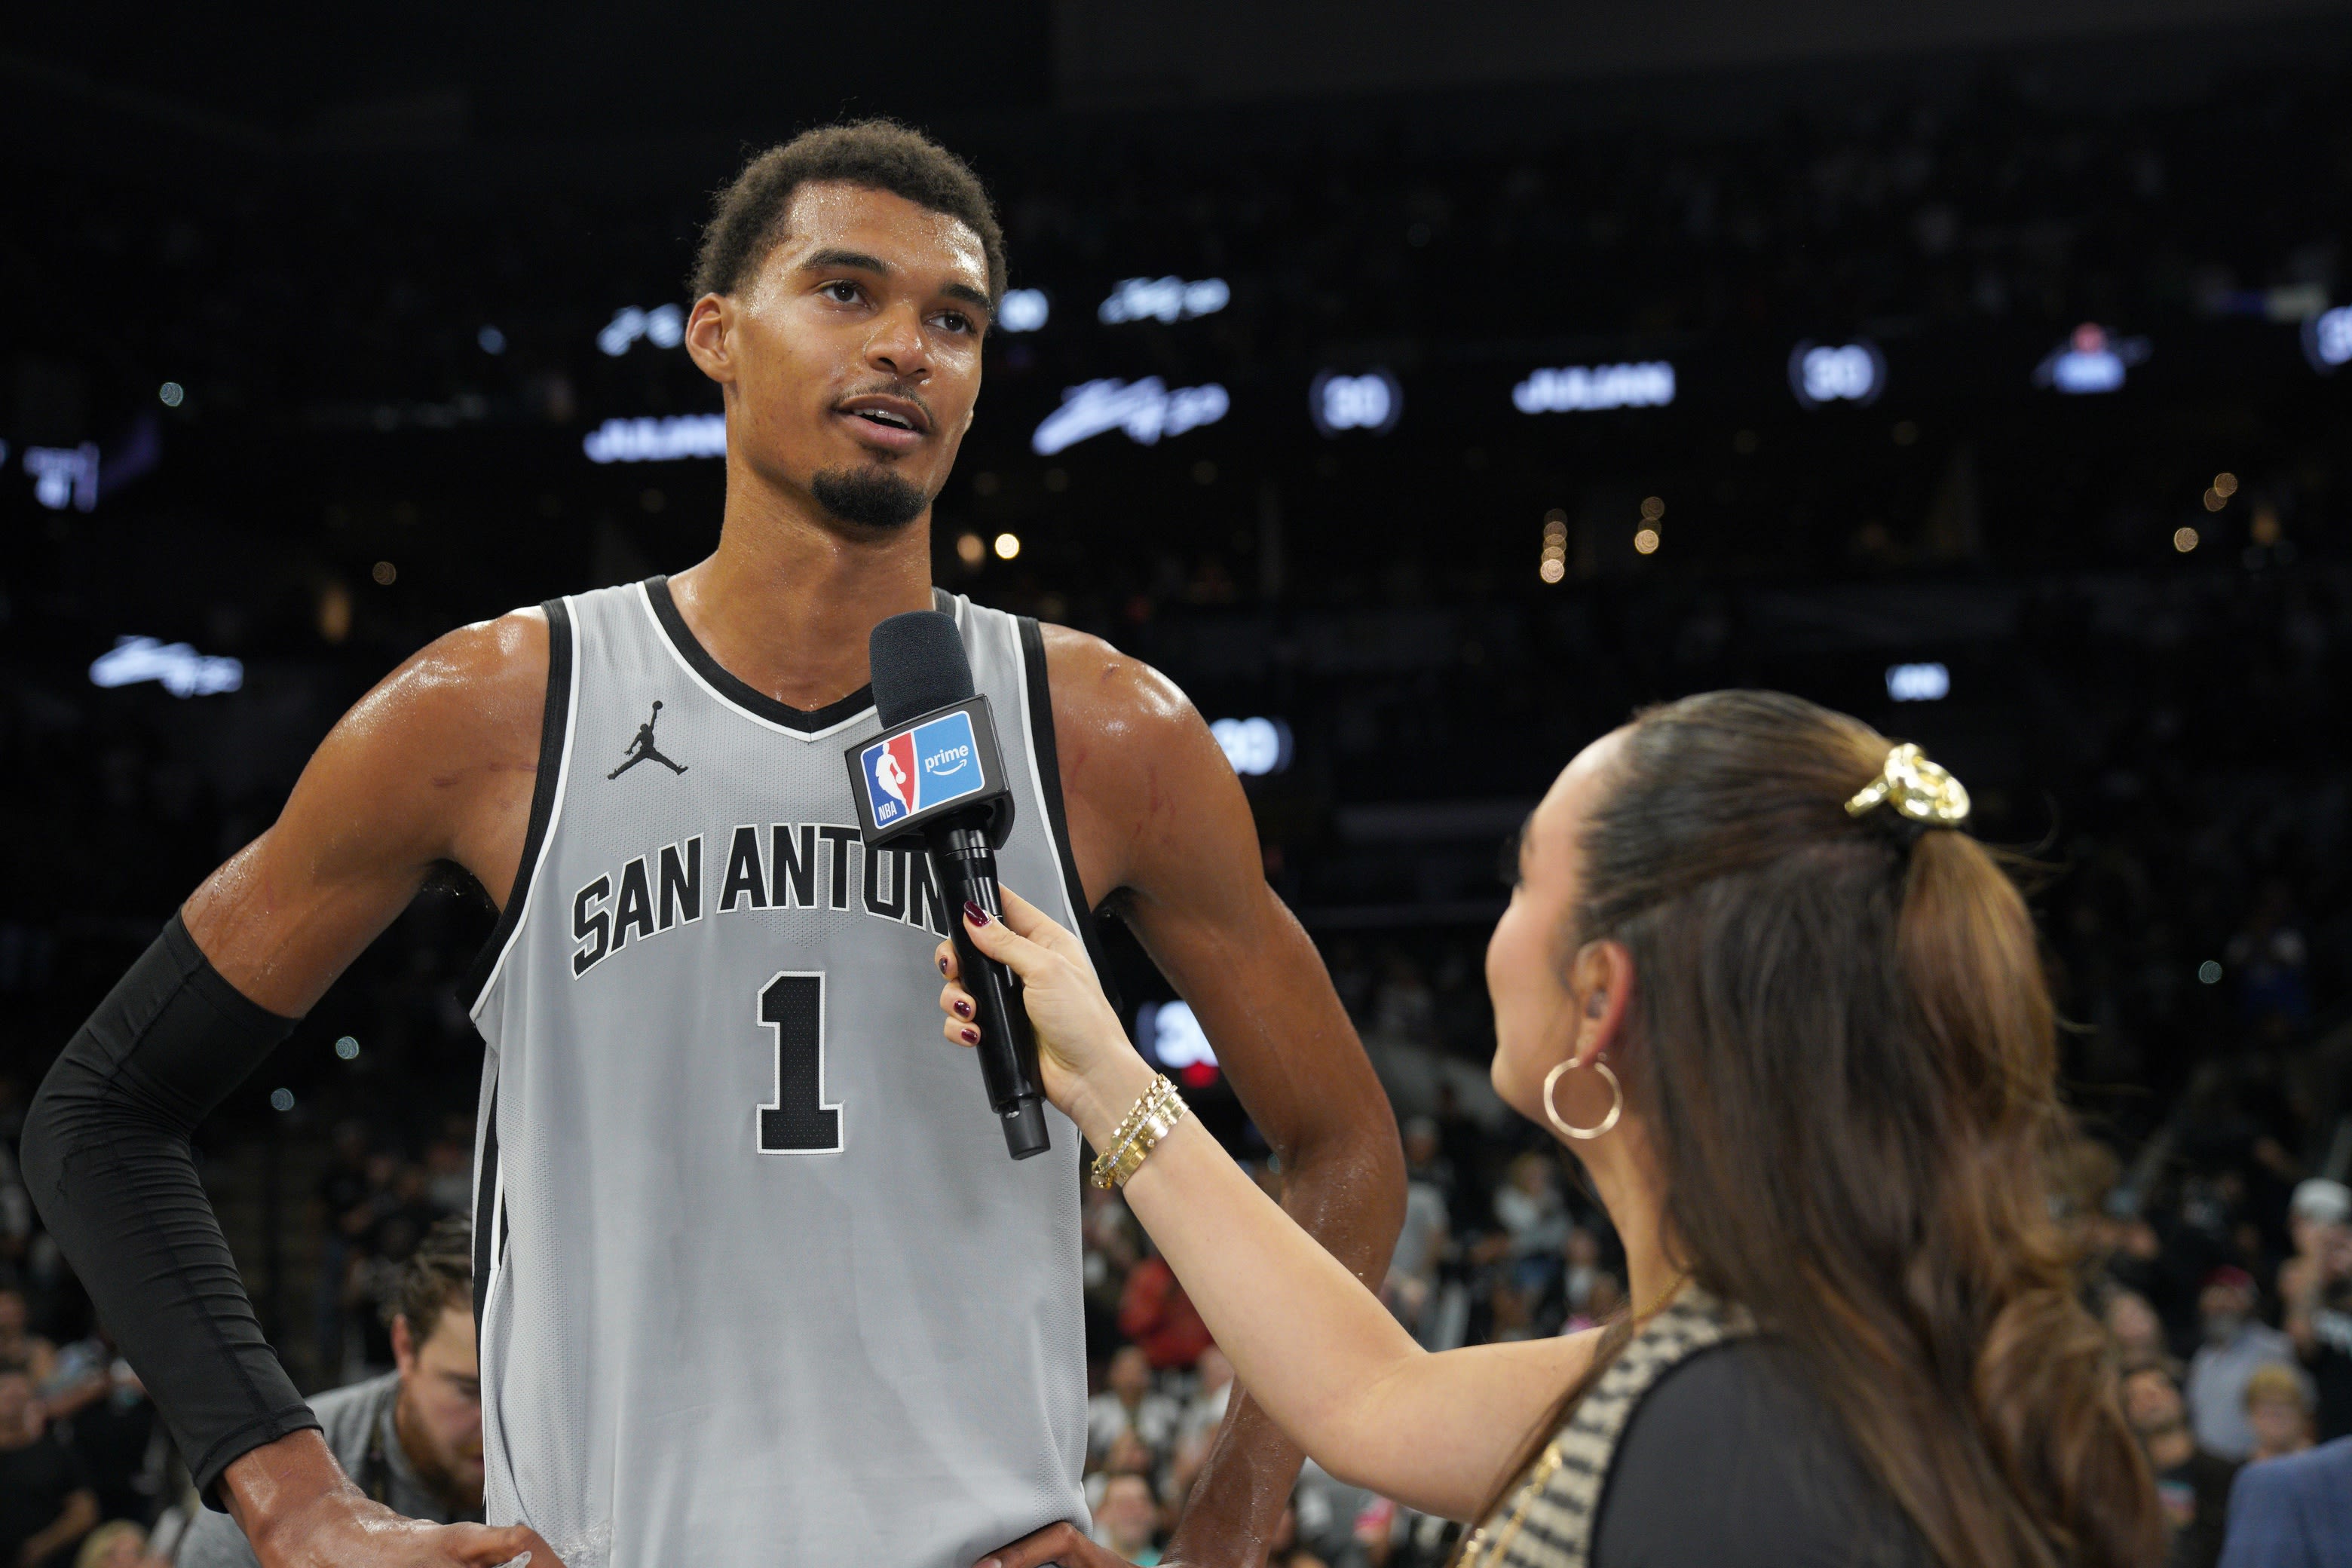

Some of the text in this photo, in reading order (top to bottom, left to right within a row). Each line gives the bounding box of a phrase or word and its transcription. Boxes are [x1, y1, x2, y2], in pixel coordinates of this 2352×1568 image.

[925, 745, 969, 773] prime
[878, 801, 897, 821] NBA
[571, 834, 704, 980] SAN
[757, 971, 844, 1154] 1
